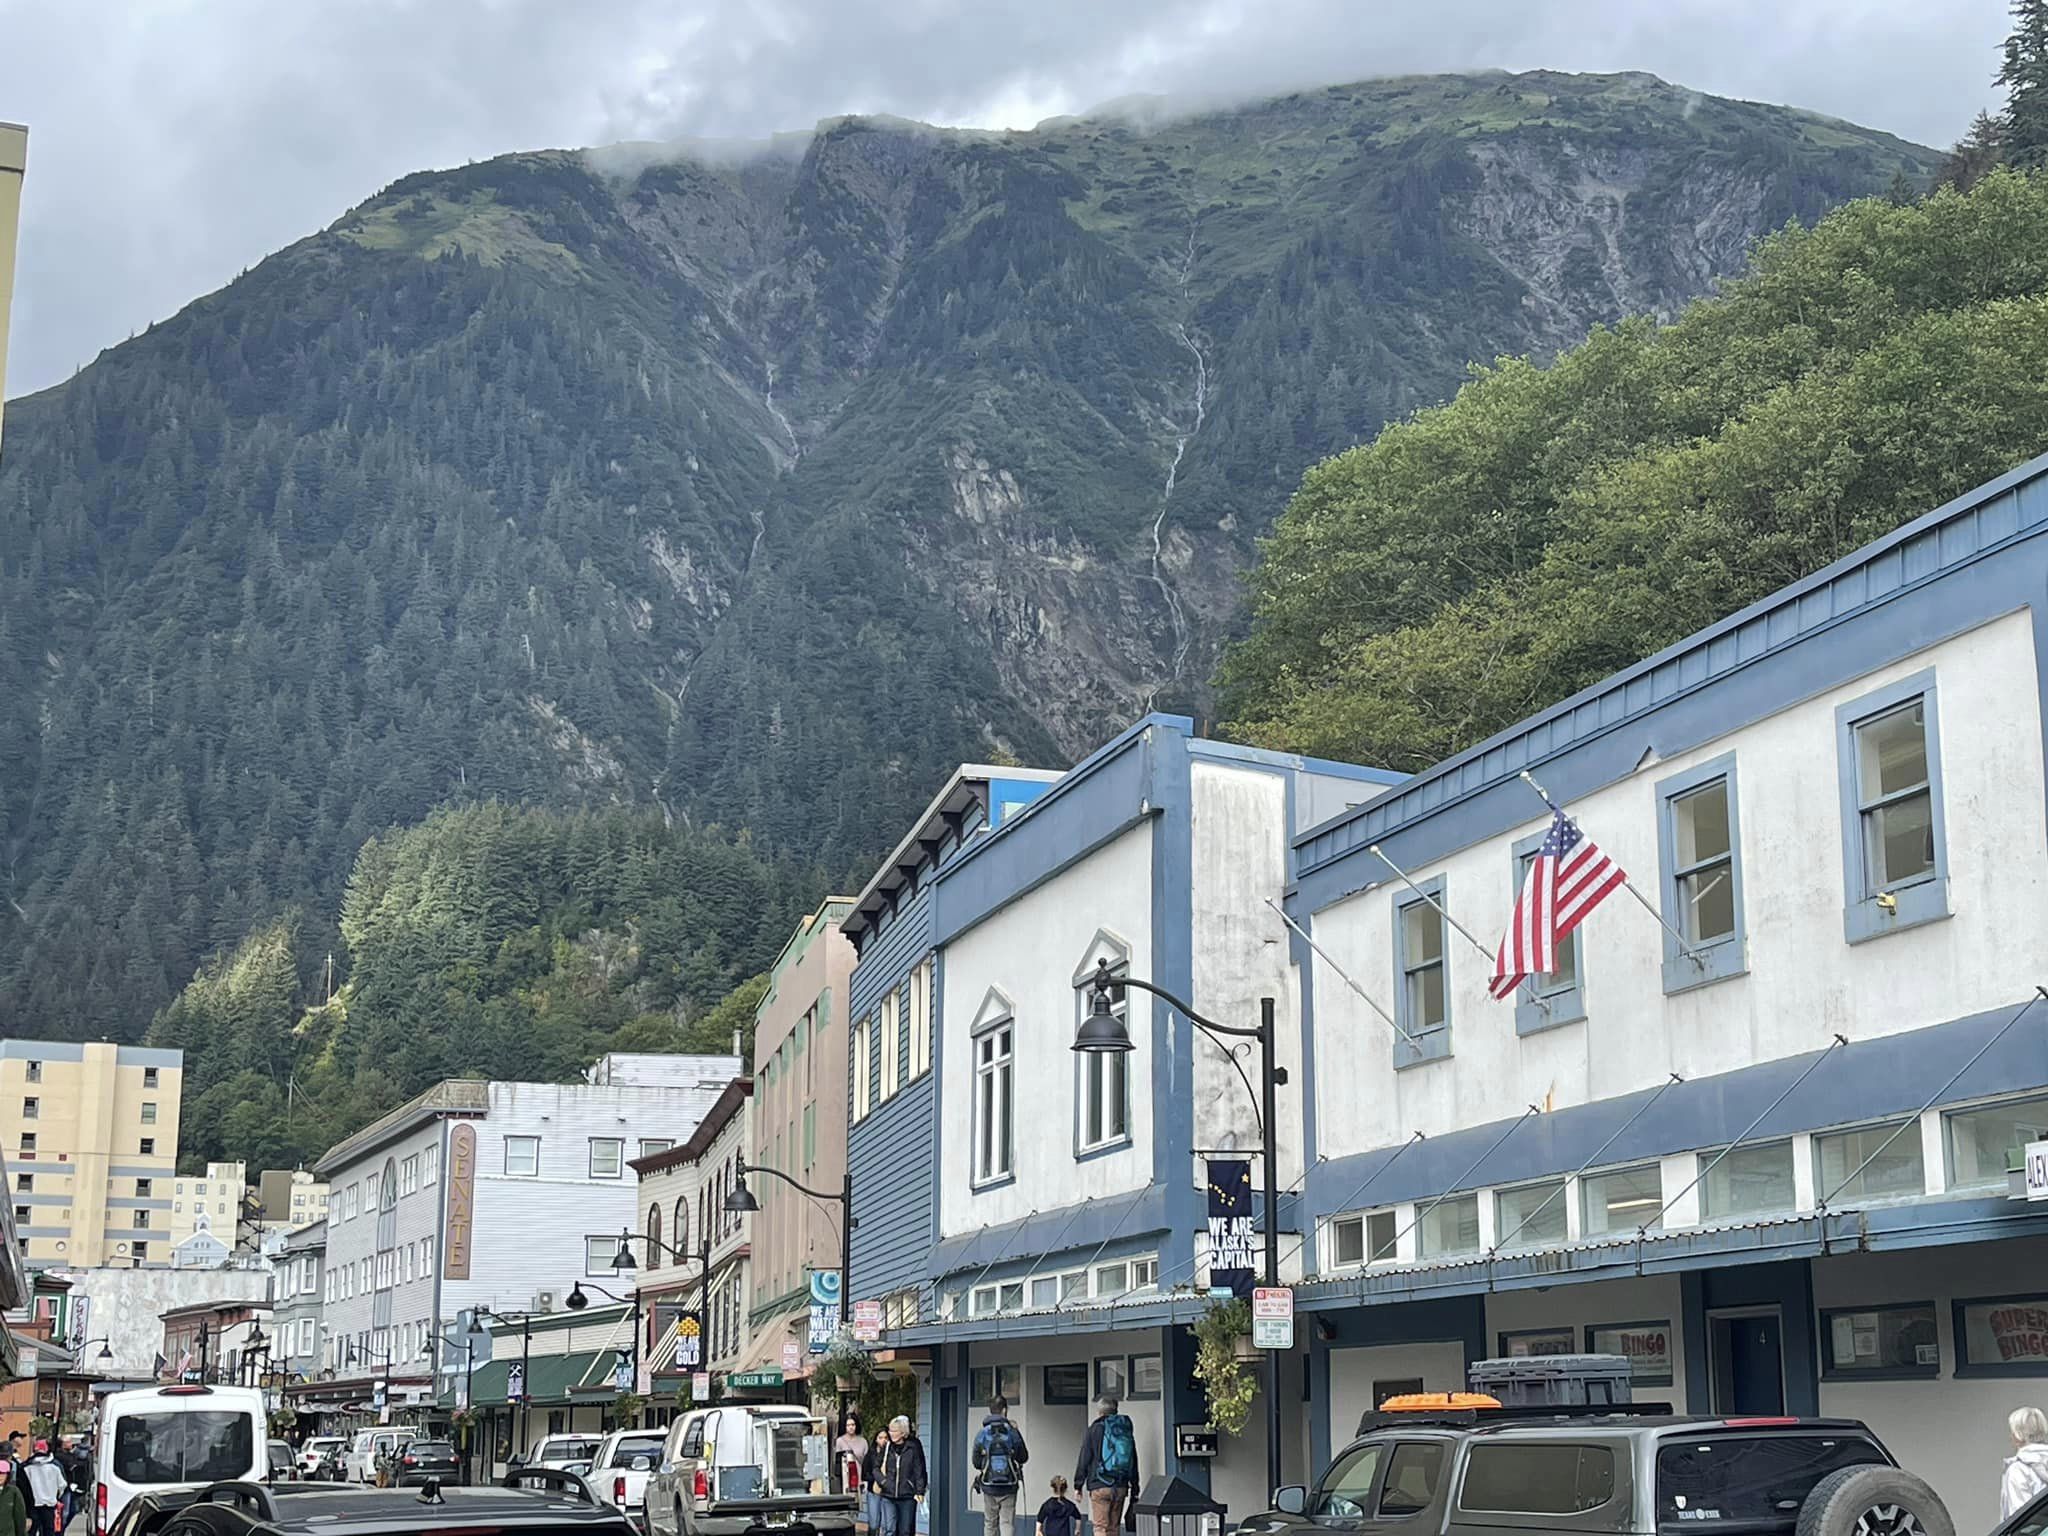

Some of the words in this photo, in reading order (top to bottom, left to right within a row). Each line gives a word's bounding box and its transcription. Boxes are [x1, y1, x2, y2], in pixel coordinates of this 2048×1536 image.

[449, 1136, 470, 1267] SENATE
[1208, 1216, 1228, 1235] WE
[1231, 1216, 1255, 1235] ARE
[1209, 1235, 1255, 1250] ALASKA'S
[1210, 1250, 1256, 1270] CAPITAL
[810, 1305, 824, 1317] WE
[825, 1305, 840, 1317] ARE
[810, 1317, 839, 1330] WATER
[809, 1330, 839, 1344] PEOP
[1621, 1333, 1665, 1357] BINGO
[734, 1375, 758, 1386] DECKER
[761, 1375, 776, 1385] WAY
